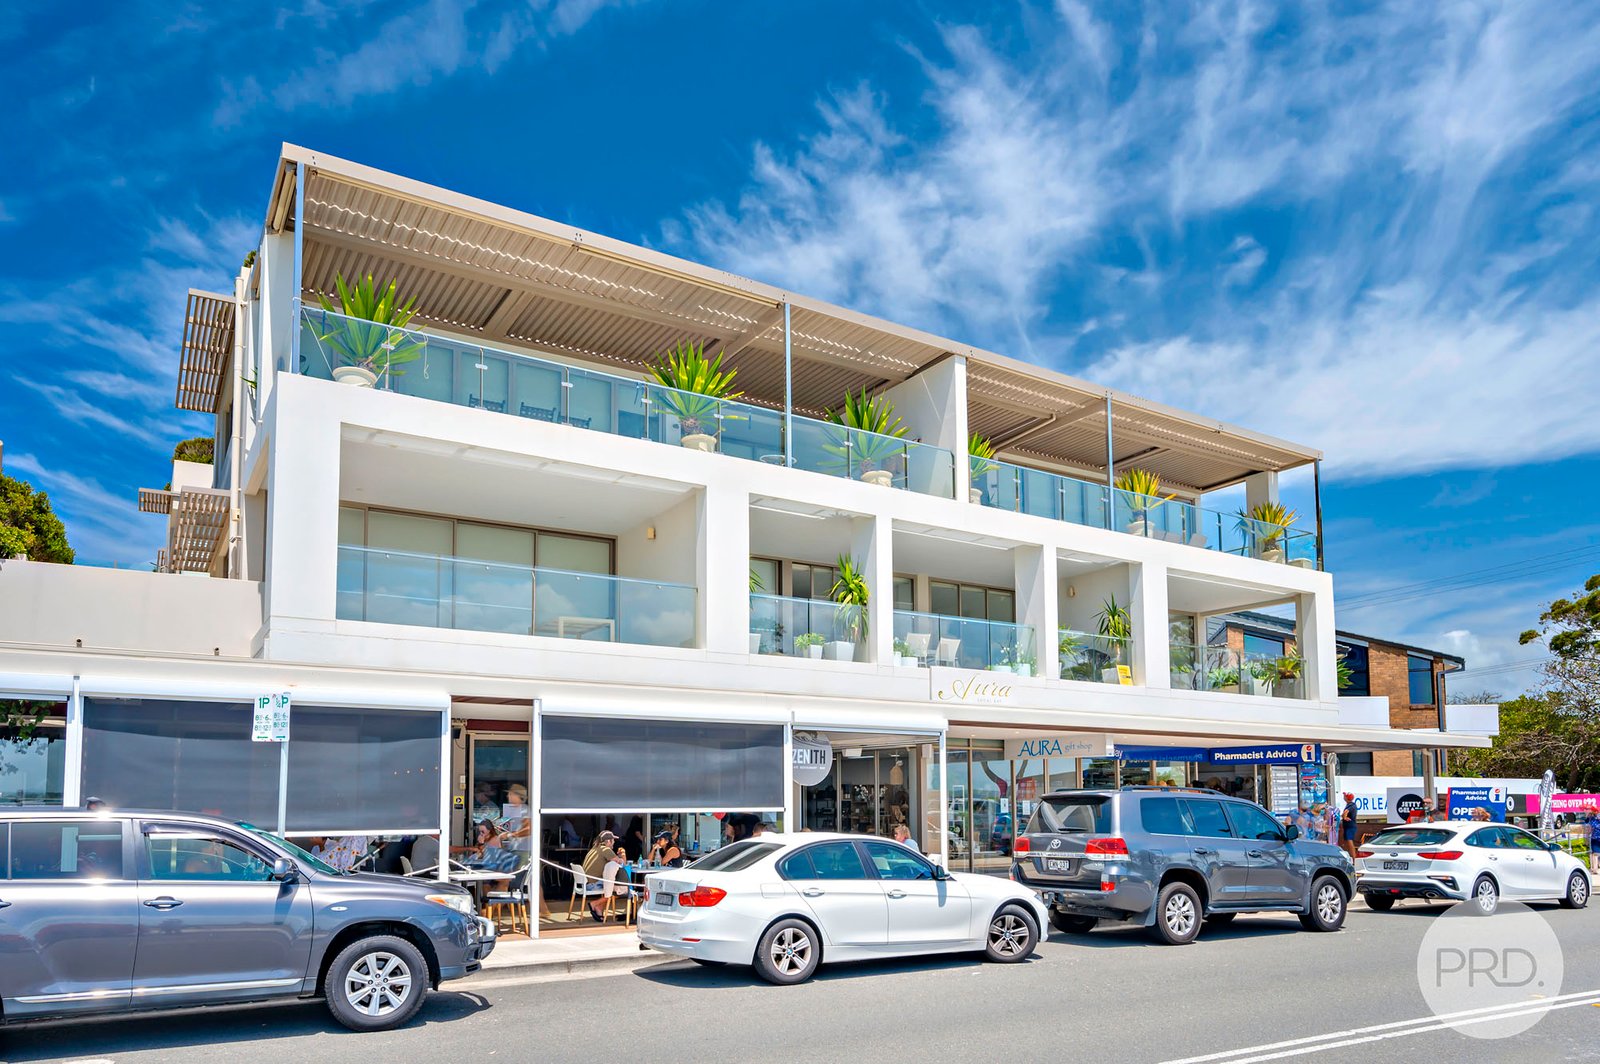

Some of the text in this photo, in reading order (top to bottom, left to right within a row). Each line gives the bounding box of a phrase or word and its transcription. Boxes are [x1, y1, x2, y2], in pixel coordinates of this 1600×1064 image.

[938, 674, 1012, 701] Aura
[258, 697, 270, 708] 1P
[1018, 740, 1062, 756] AURA
[1214, 749, 1298, 760] Pharmacist Advice
[1452, 807, 1475, 816] OPE
